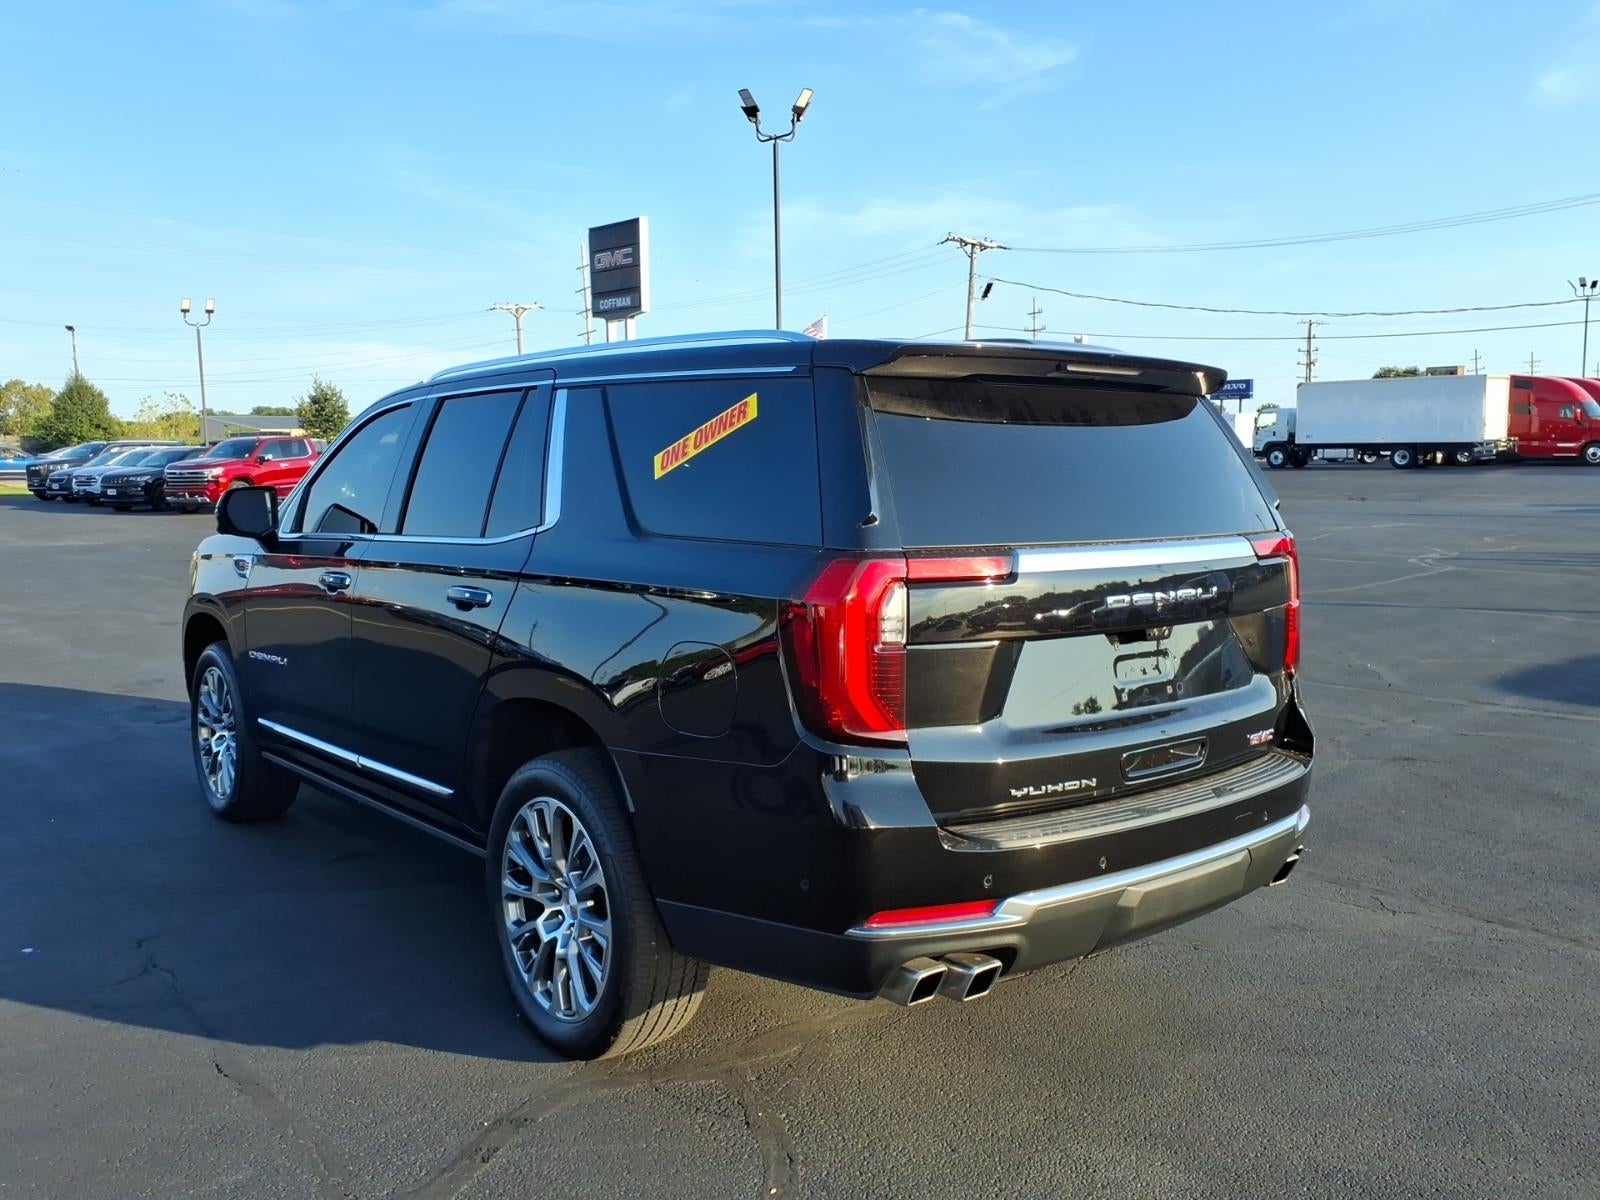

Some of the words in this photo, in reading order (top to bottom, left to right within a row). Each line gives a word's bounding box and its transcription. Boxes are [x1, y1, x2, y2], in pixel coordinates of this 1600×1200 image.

[594, 247, 633, 270] GMC
[599, 296, 631, 309] COFFMAN
[660, 437, 690, 471] ONE
[693, 400, 748, 450] OWNER
[1105, 586, 1218, 609] DENALI
[248, 650, 288, 666] DENALI
[1009, 777, 1097, 798] YUKON
